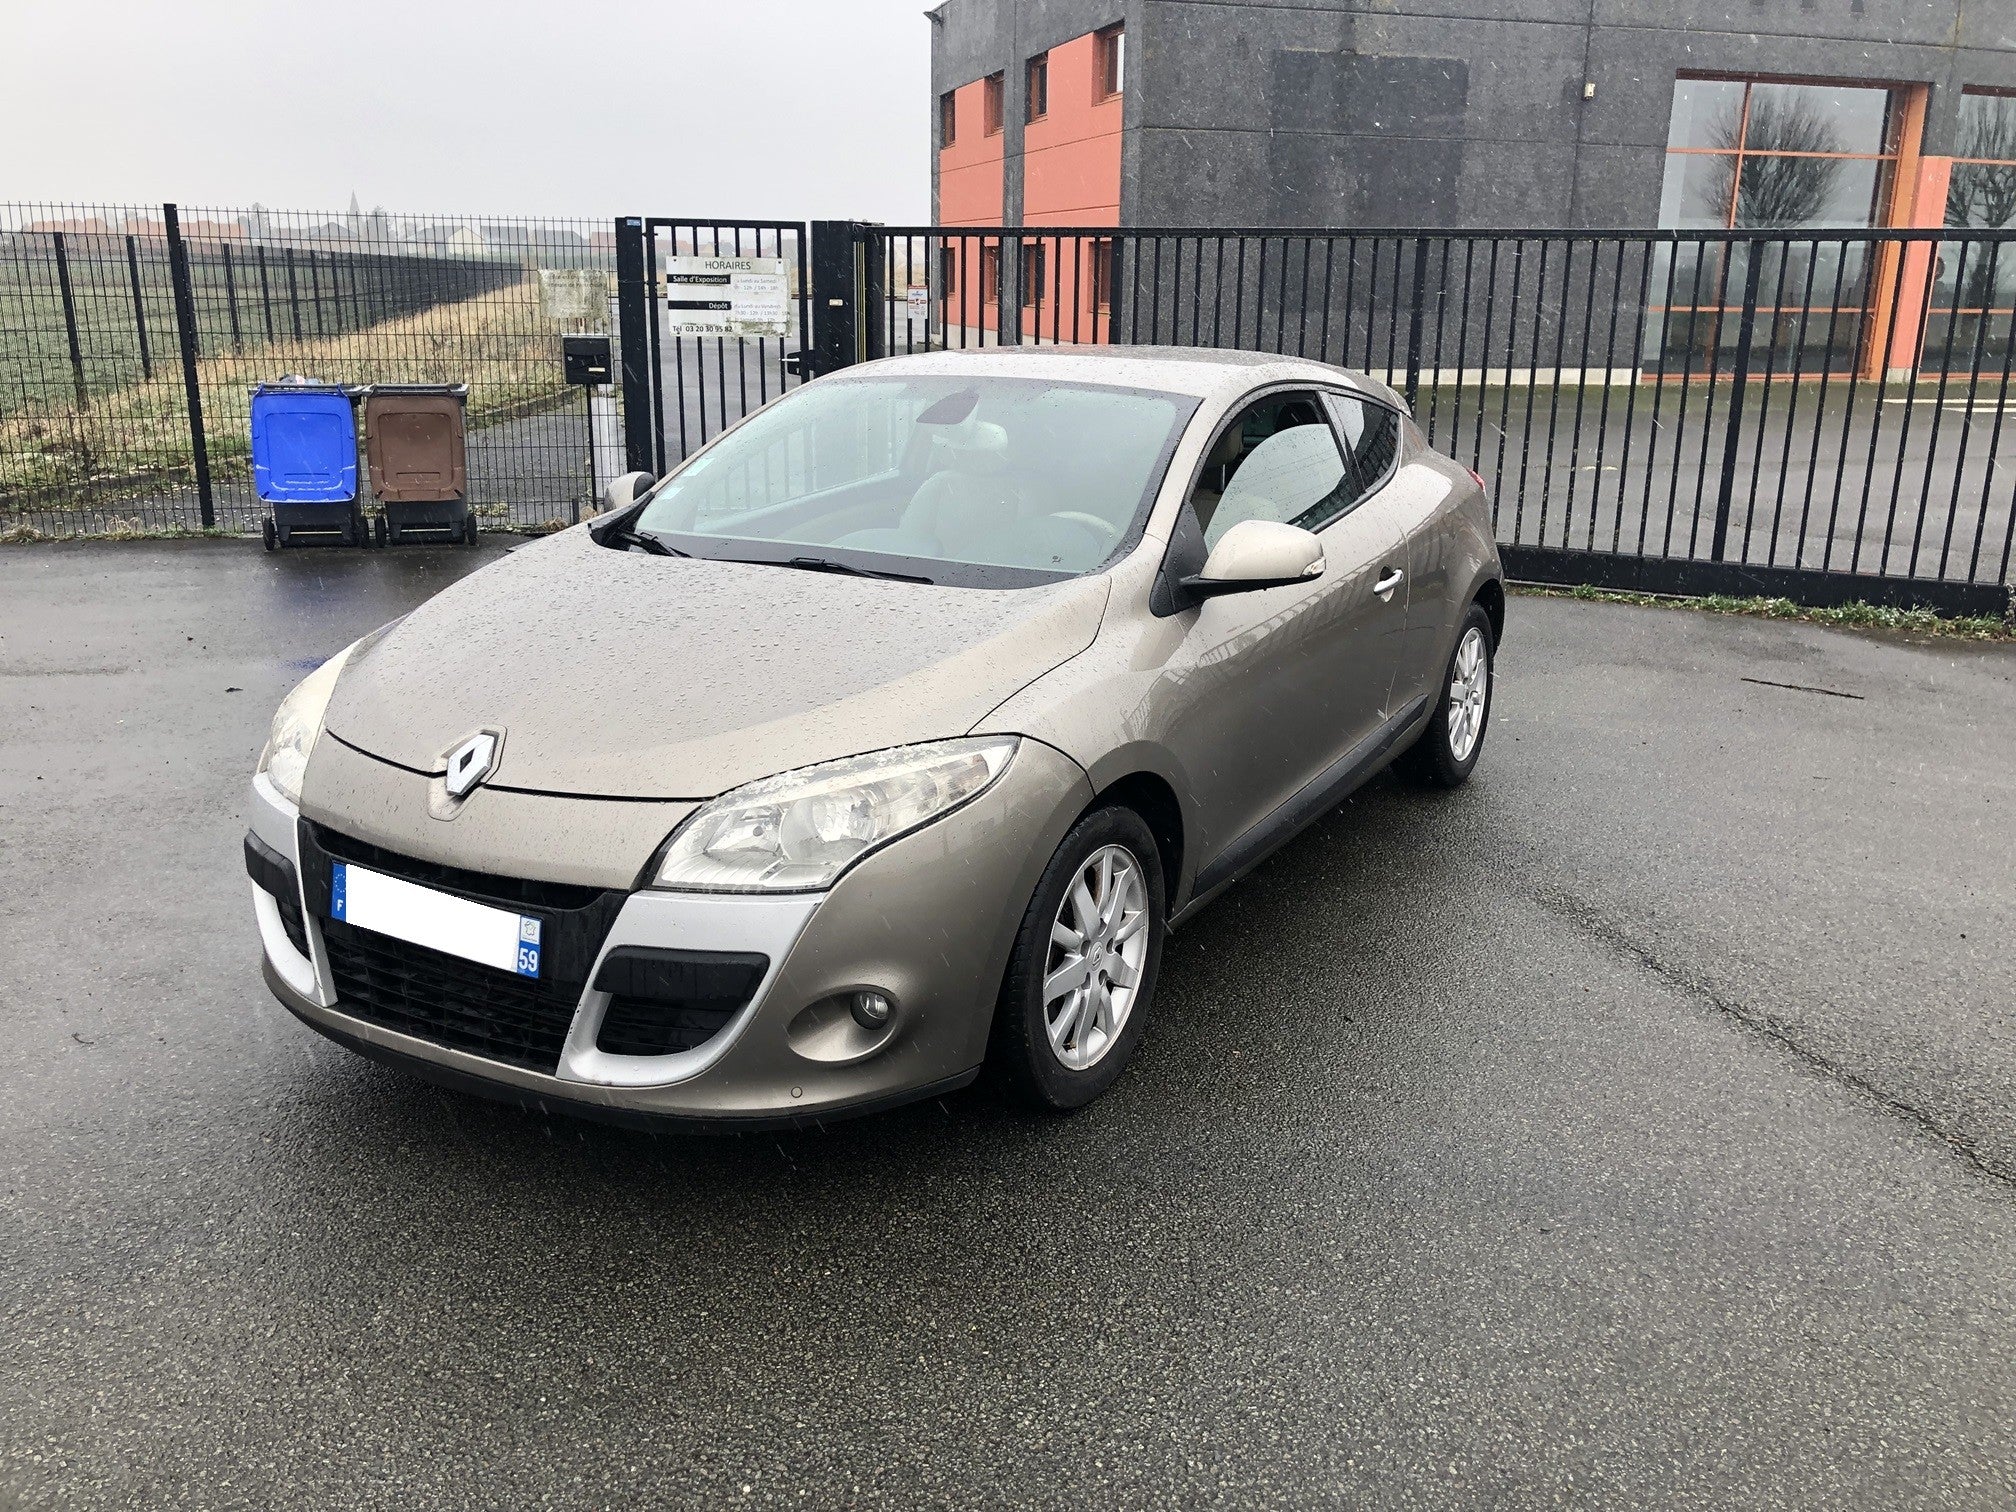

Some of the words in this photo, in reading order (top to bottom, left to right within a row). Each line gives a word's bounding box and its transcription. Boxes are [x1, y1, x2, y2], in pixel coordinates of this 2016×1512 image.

[705, 260, 751, 270] HORAIRES
[673, 275, 688, 283] Salle
[689, 275, 727, 284] d'Exposition
[708, 302, 728, 310] Dépôt
[705, 325, 713, 333] 30
[336, 899, 344, 912] F
[518, 947, 538, 972] 59
